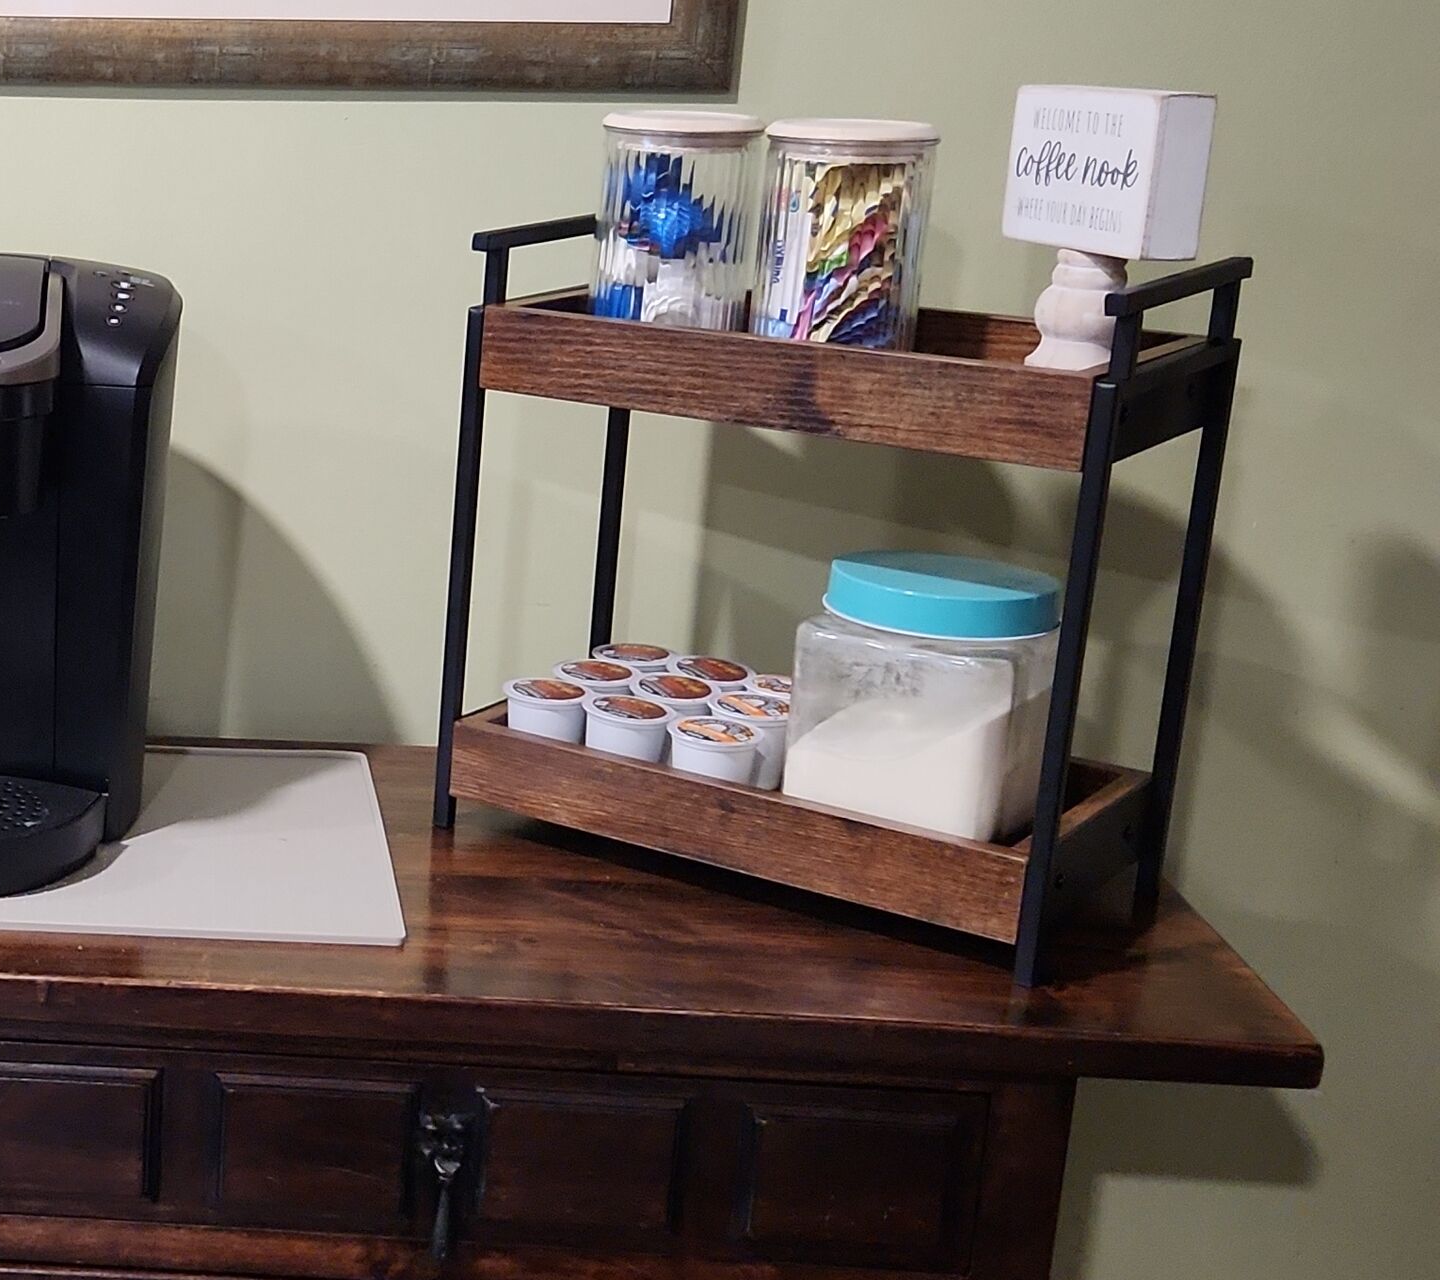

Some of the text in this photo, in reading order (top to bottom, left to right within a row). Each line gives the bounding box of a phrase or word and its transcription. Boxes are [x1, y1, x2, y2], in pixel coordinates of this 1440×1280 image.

[1033, 106, 1124, 137] WELCOME TO THE
[1081, 148, 1140, 191] nook
[1016, 195, 1124, 234] WHERE YOUR DAY BEGINS
